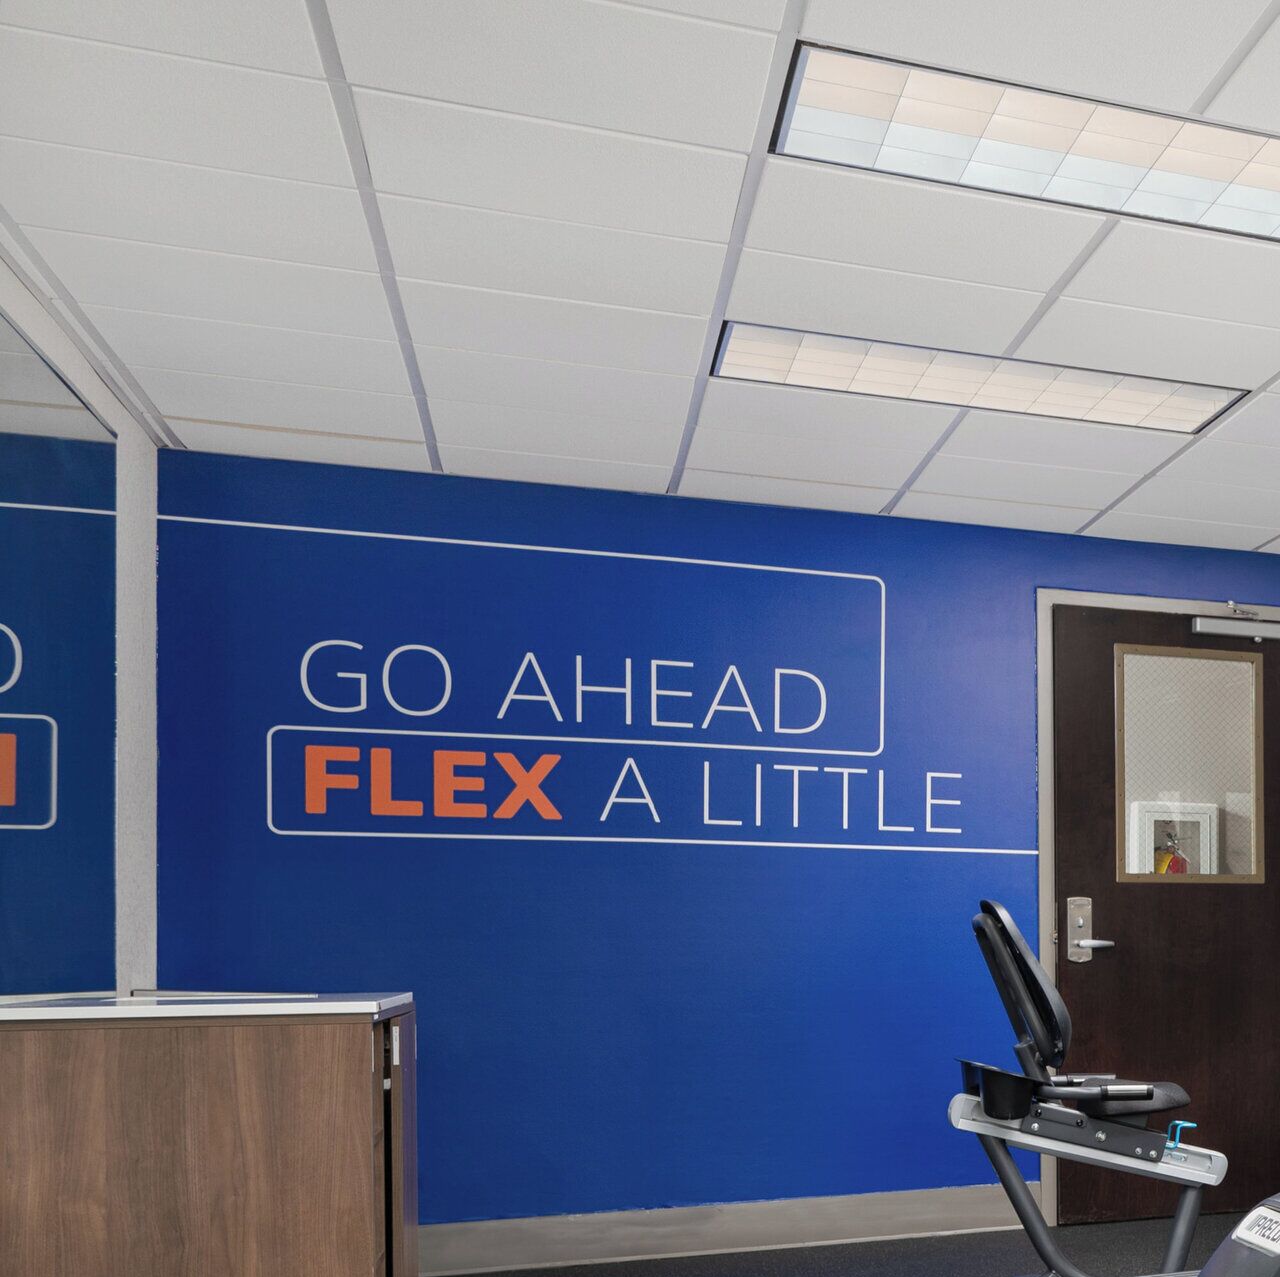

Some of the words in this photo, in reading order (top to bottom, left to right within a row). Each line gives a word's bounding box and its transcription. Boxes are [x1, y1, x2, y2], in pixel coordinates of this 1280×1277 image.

[301, 640, 451, 716] GO
[496, 652, 828, 735] AHEAD
[305, 746, 560, 819] FLEX
[600, 758, 660, 822] A
[704, 761, 962, 833] LITTLE
